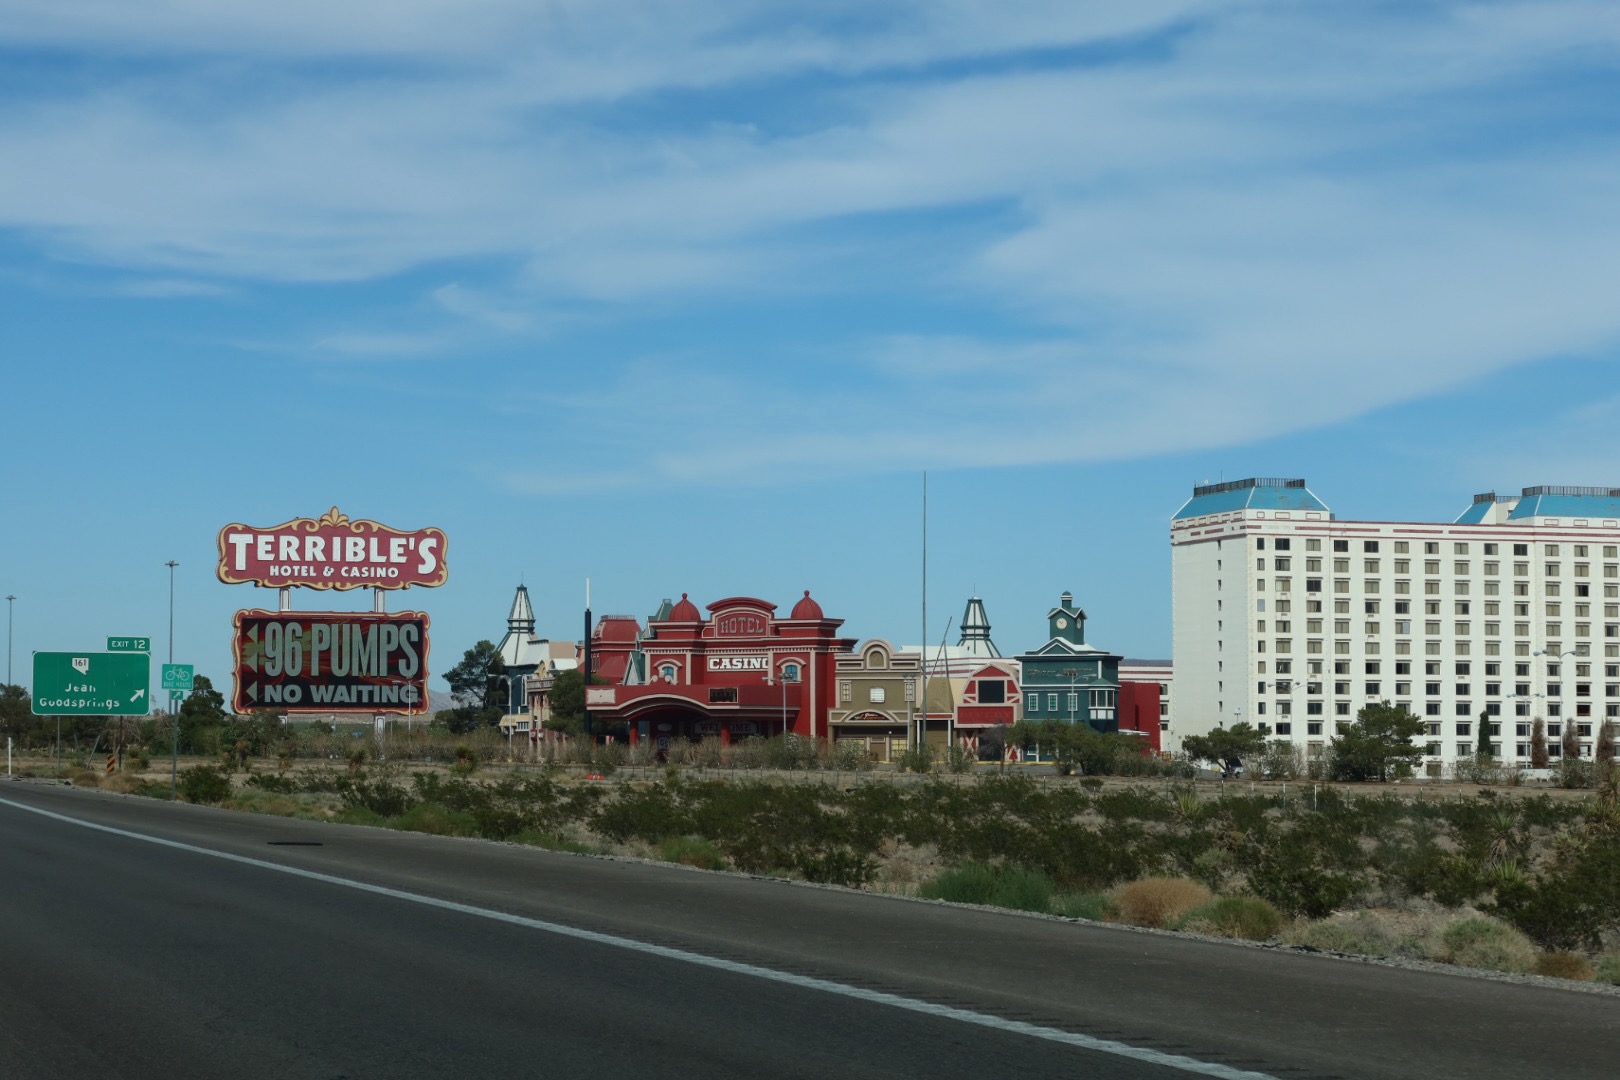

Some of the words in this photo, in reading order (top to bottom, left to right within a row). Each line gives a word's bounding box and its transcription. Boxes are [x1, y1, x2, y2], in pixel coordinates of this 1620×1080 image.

[229, 533, 437, 575] TERRIBLE'S
[270, 565, 316, 577] HOTEL
[323, 567, 334, 577] &
[341, 566, 399, 578] CASINO
[721, 617, 763, 633] HOTEL
[133, 640, 146, 649] 12
[264, 621, 303, 677] 96
[311, 623, 418, 678] PUMPS
[74, 659, 87, 667] 161
[65, 683, 96, 693] Jean
[264, 684, 302, 703] NO
[310, 684, 418, 703] WAITING
[40, 697, 120, 710] Goodsprings
[700, 723, 751, 732] WELOME
